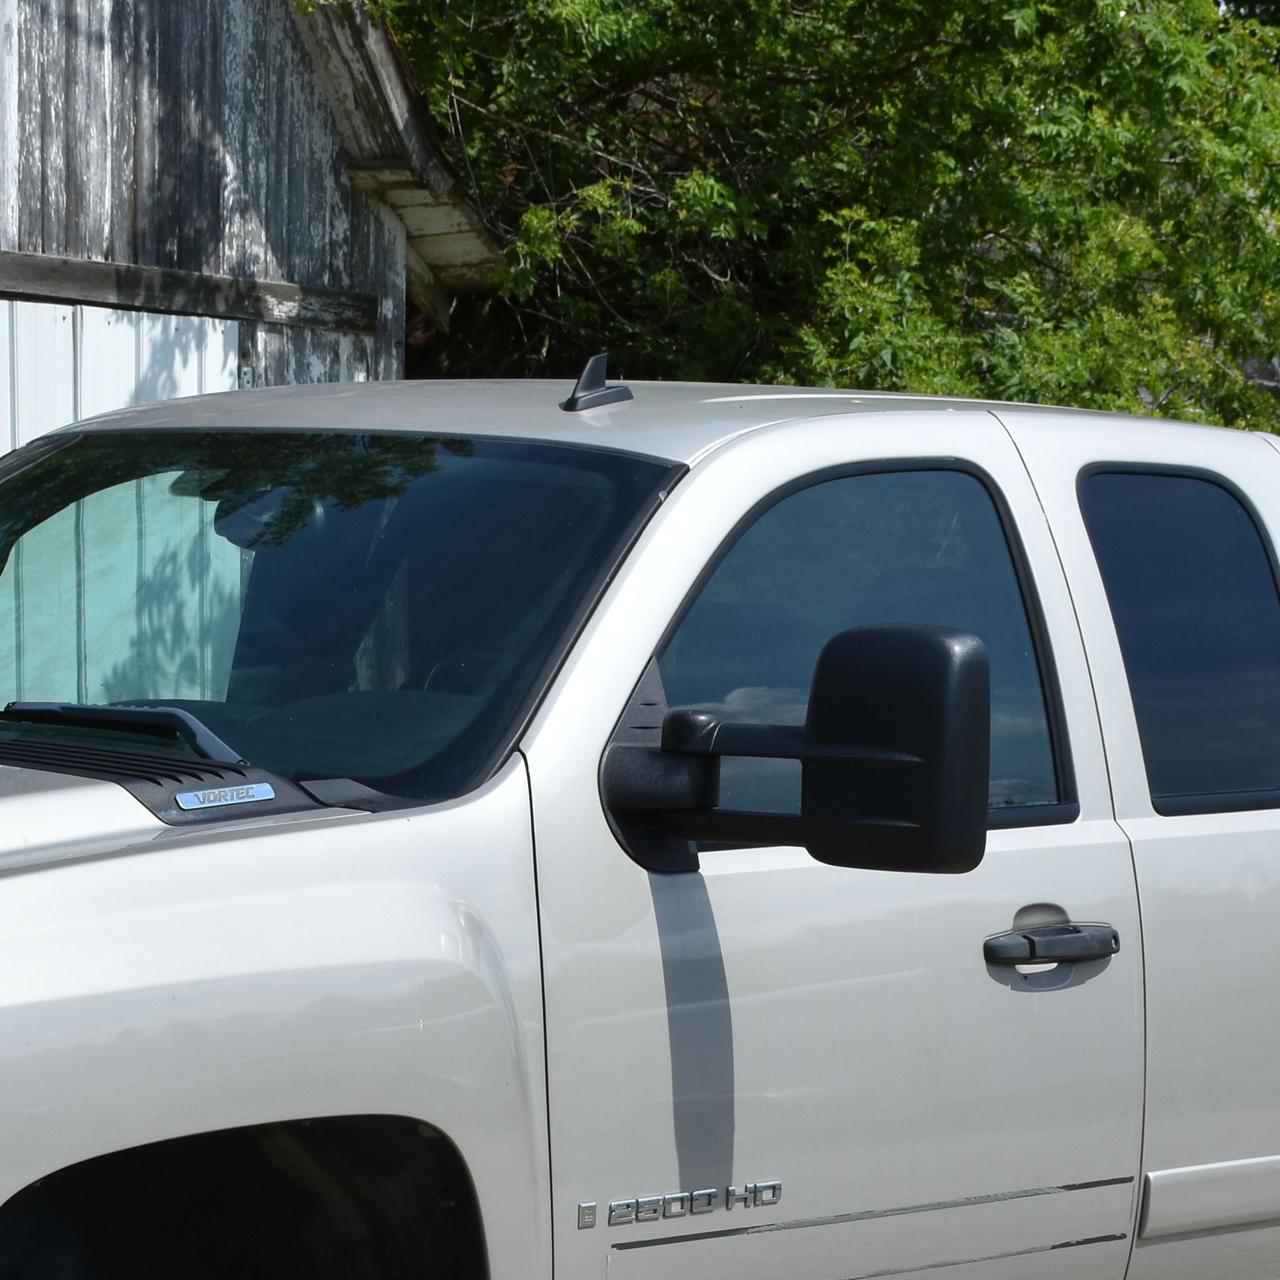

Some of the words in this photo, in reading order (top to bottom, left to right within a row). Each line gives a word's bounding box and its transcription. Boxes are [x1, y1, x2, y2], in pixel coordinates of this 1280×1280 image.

[194, 787, 255, 804] VORTEC
[607, 1187, 718, 1228] 2500
[726, 1180, 783, 1211] HD
